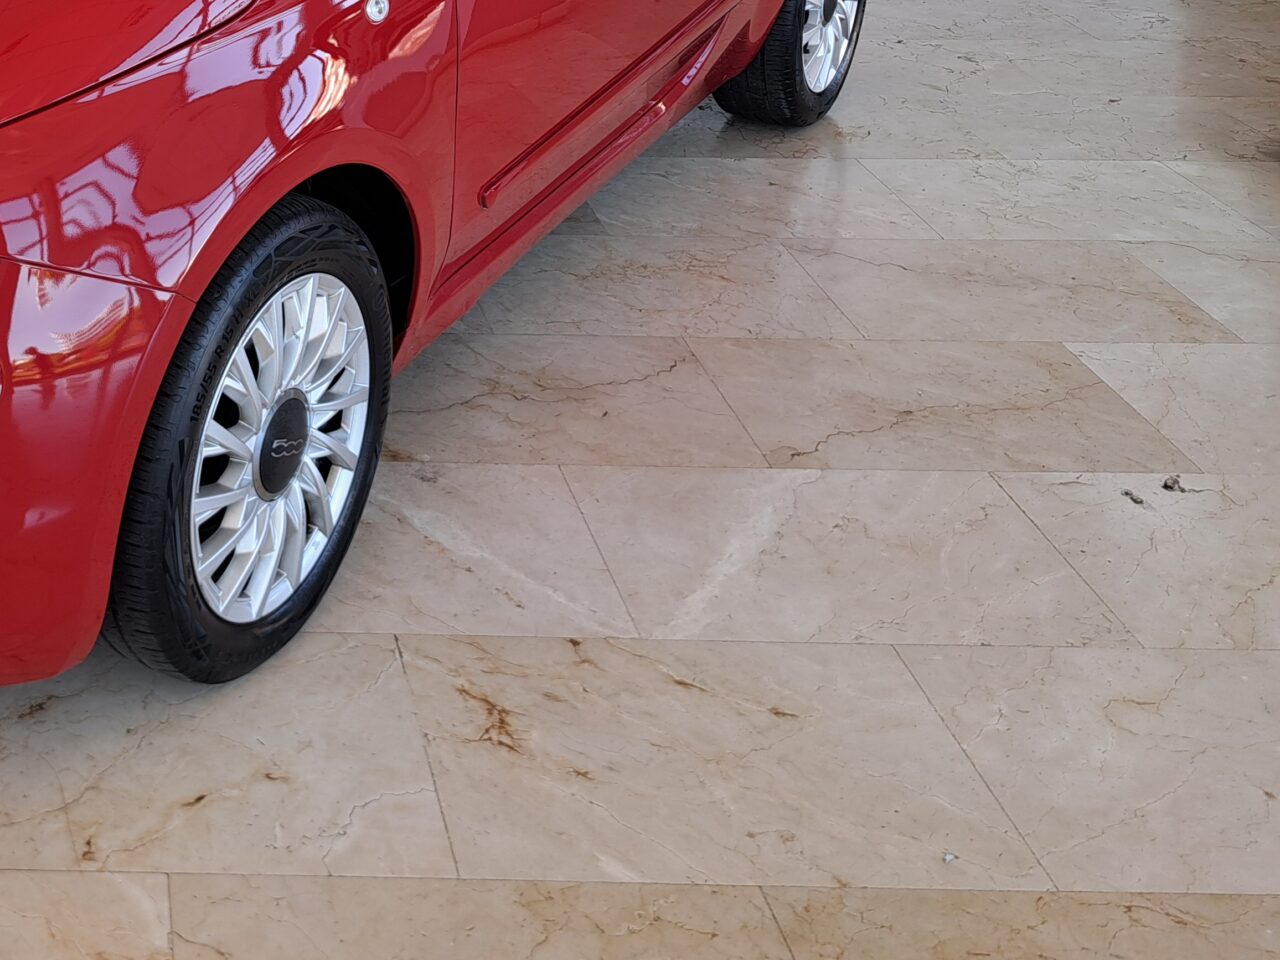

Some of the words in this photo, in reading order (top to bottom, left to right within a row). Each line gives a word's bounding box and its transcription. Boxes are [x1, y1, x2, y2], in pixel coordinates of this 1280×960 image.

[190, 364, 217, 423] 185/55
[214, 344, 225, 360] R
[271, 438, 305, 458] 500
